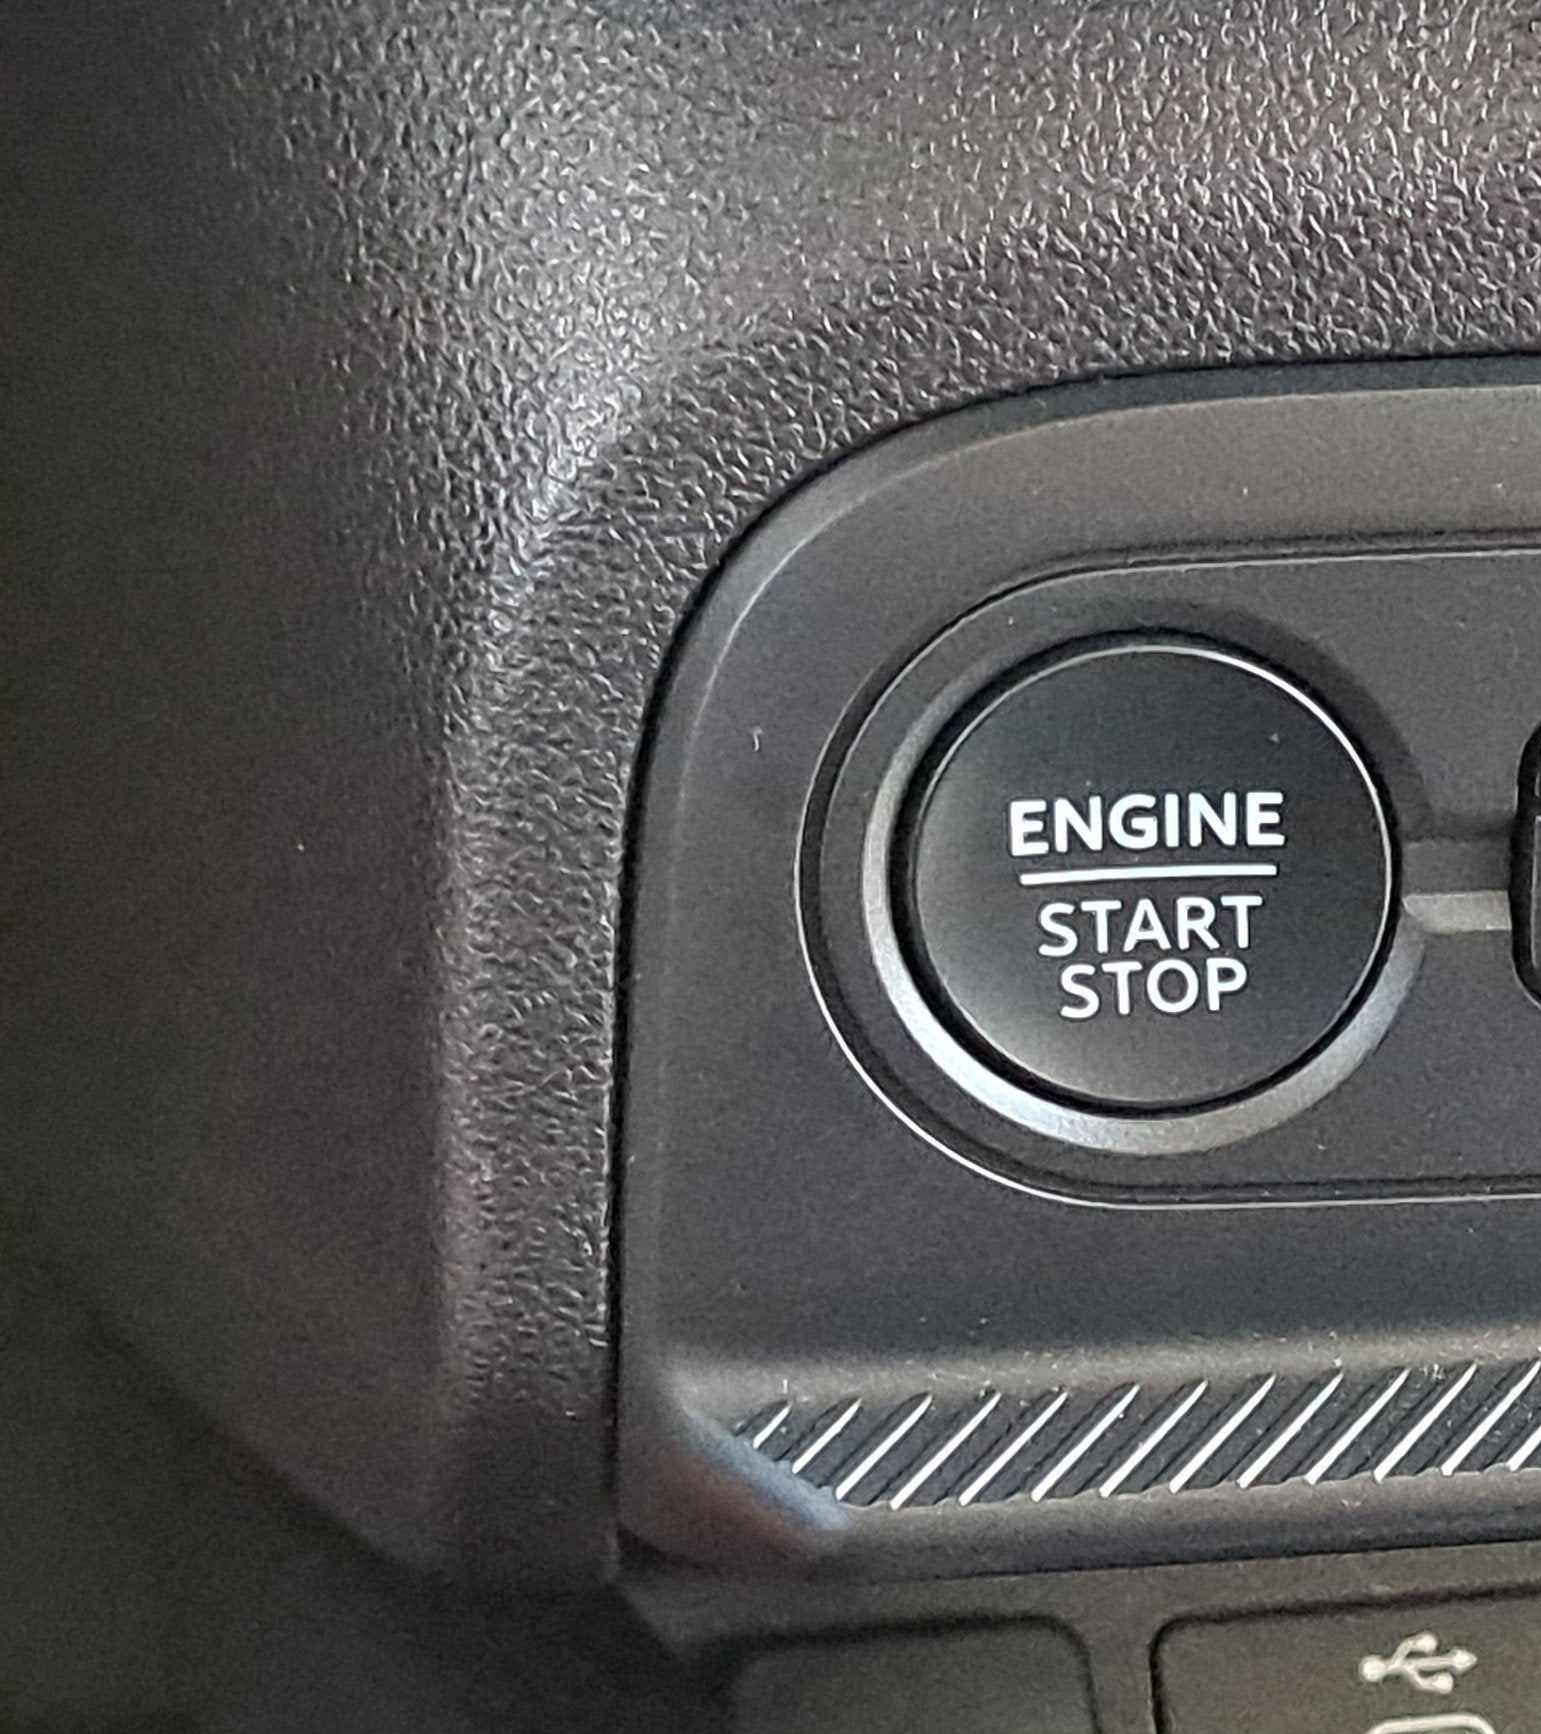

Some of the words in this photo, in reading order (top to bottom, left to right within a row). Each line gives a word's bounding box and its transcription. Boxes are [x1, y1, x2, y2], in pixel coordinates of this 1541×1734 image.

[1009, 791, 1285, 856] ENGINE
[1038, 895, 1263, 957] START
[1060, 958, 1248, 1018] STOP
